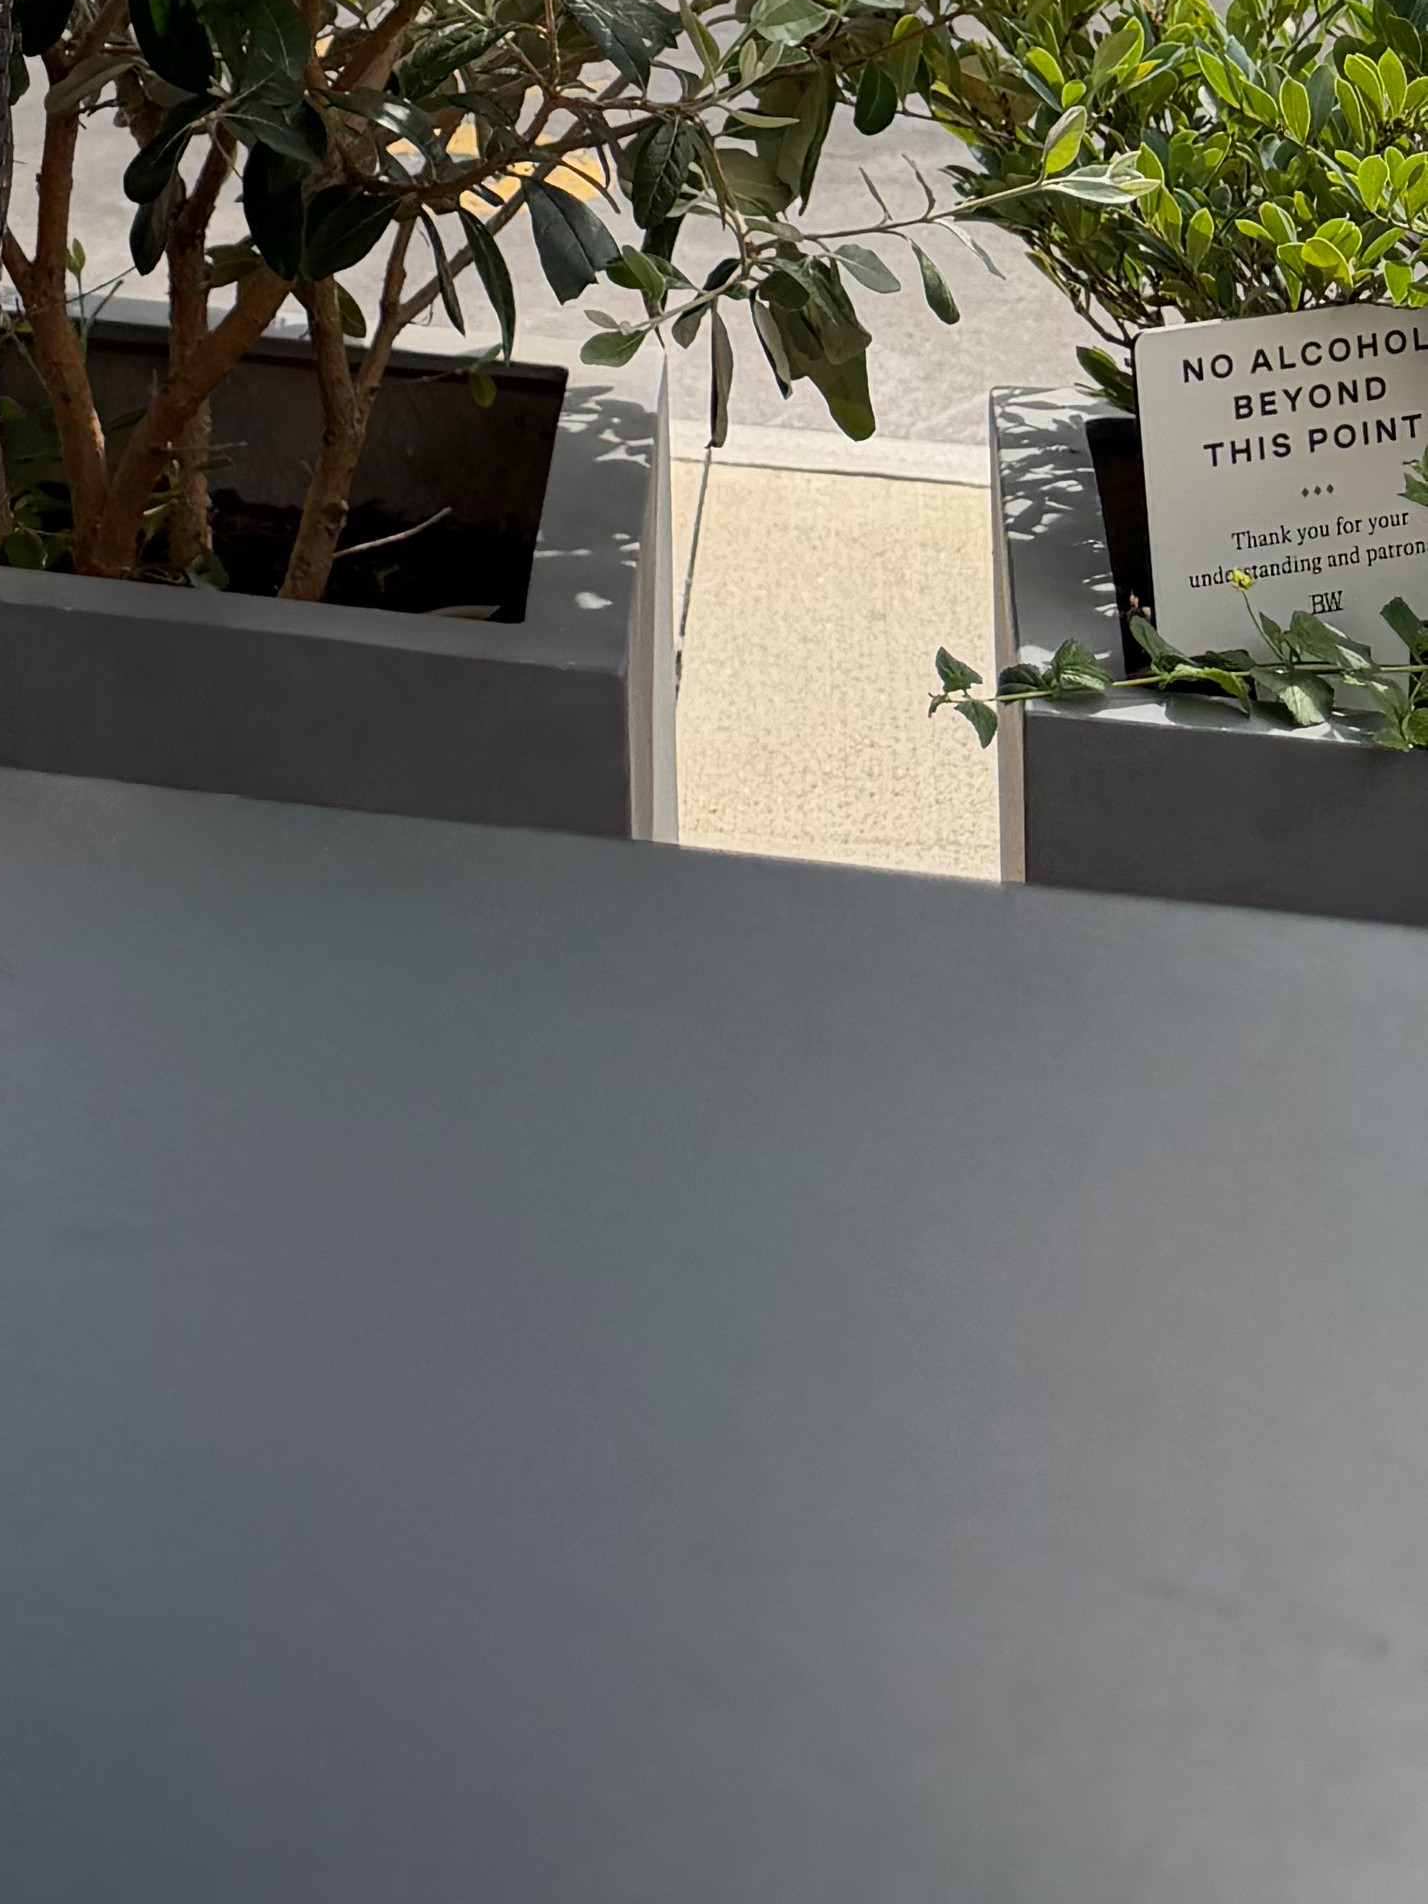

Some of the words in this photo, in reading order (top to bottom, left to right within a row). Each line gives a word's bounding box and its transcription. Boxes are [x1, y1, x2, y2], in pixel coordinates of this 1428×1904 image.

[1182, 353, 1234, 383] NO
[1250, 327, 1428, 374] ALCOHOL
[1234, 376, 1387, 420] BEYOND
[1203, 433, 1292, 467] THIS
[1308, 413, 1422, 453] POINT
[1231, 525, 1292, 550] Thank
[1296, 524, 1330, 545] you
[1336, 516, 1363, 536] for
[1367, 512, 1409, 535] your
[1189, 555, 1322, 589] undestanding
[1327, 545, 1360, 568] and
[1365, 539, 1428, 567] patron
